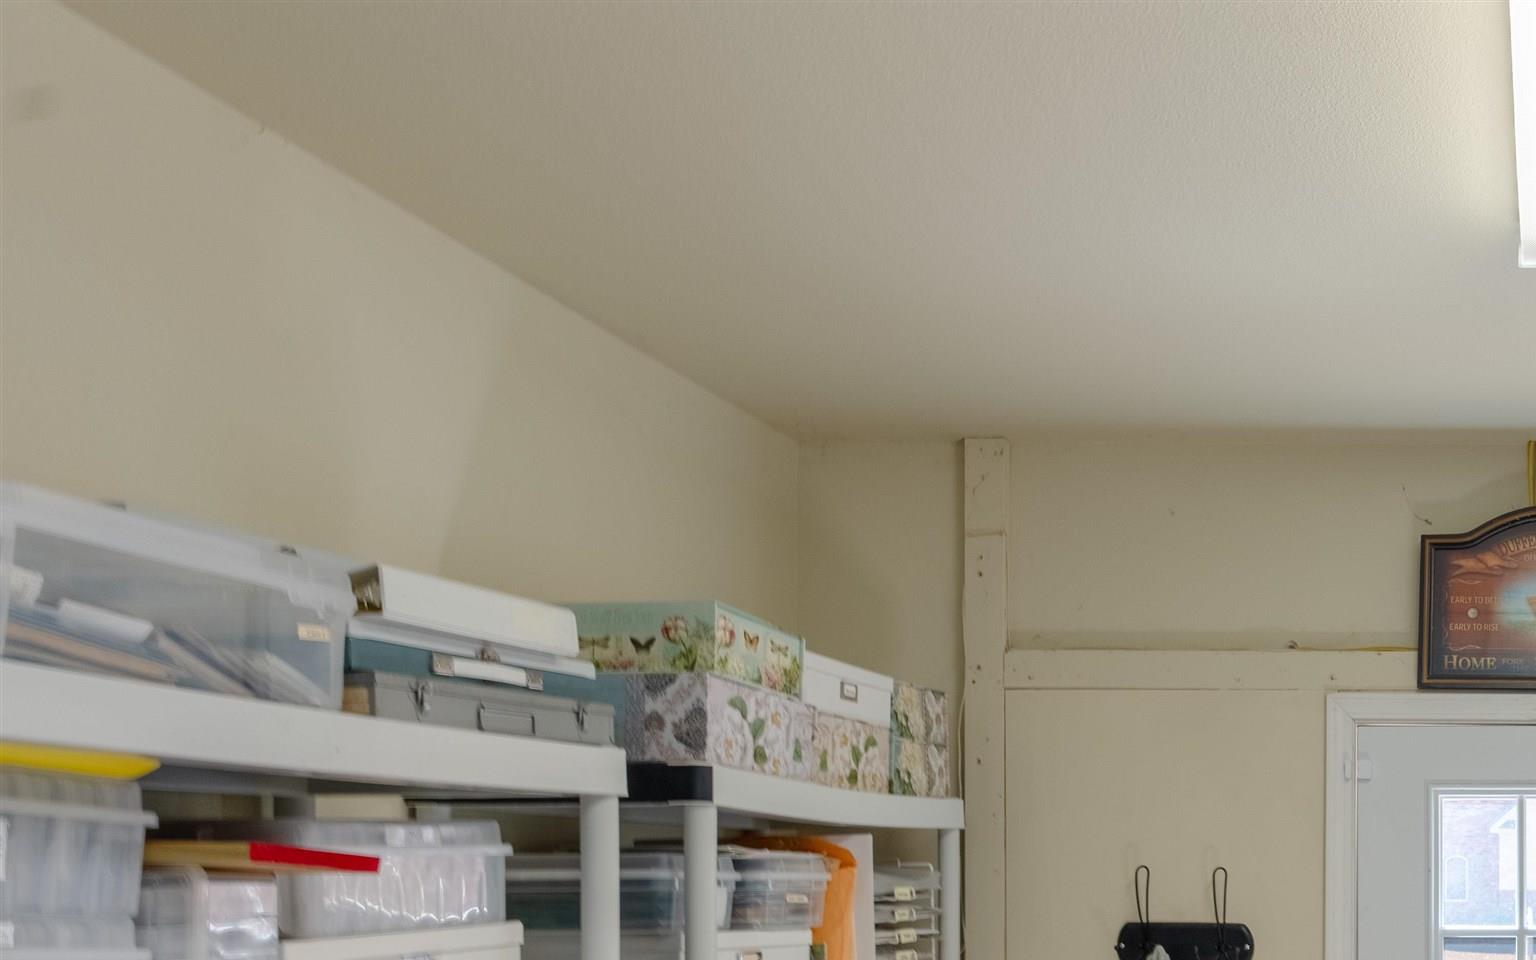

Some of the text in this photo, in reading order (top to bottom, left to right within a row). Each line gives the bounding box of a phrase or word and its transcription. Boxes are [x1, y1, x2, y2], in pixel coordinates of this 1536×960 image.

[1450, 595, 1473, 605] EARLY
[1449, 623, 1500, 633] EARLY TO RISE
[1443, 653, 1497, 673] HOME
